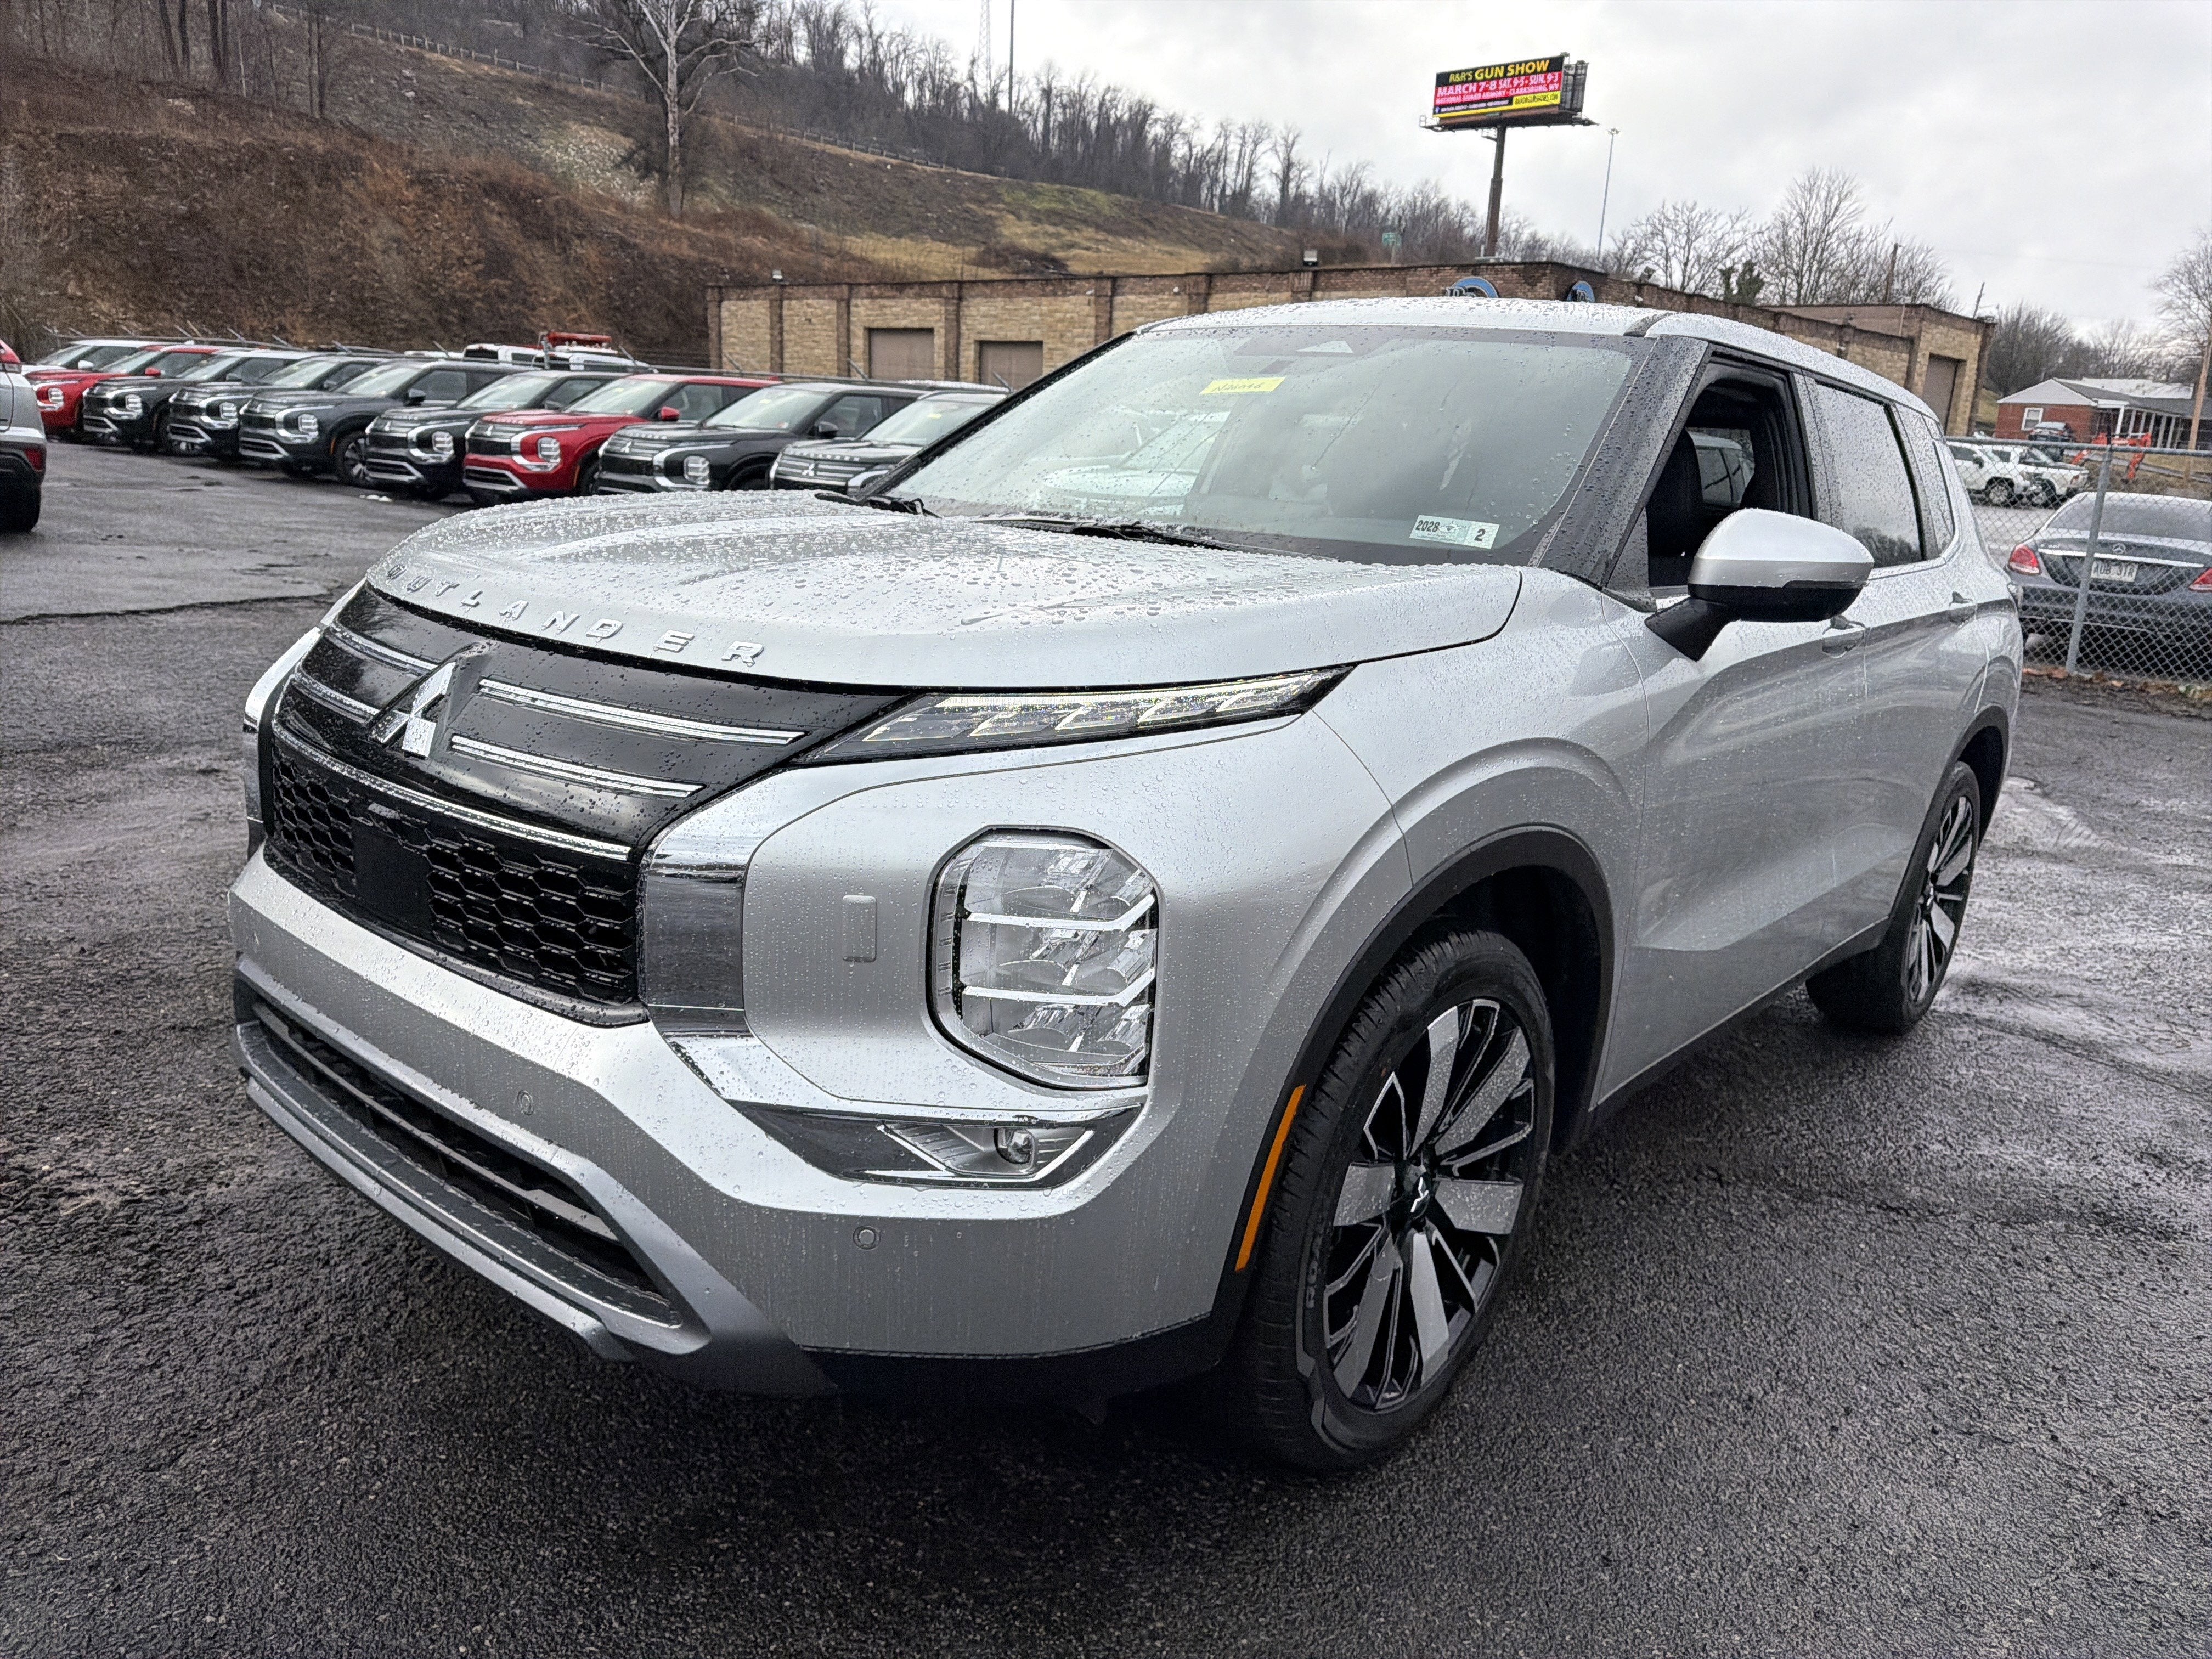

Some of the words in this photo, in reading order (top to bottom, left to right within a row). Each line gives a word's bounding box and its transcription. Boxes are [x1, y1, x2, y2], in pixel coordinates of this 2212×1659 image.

[1475, 65, 1504, 80] GUN
[1506, 59, 1550, 76] SHOW
[1437, 82, 1477, 97] MARCH
[1479, 80, 1497, 93] 7-8
[1415, 520, 1440, 533] 2028
[1474, 528, 1486, 541] 2
[386, 563, 765, 667] OUTLANDER
